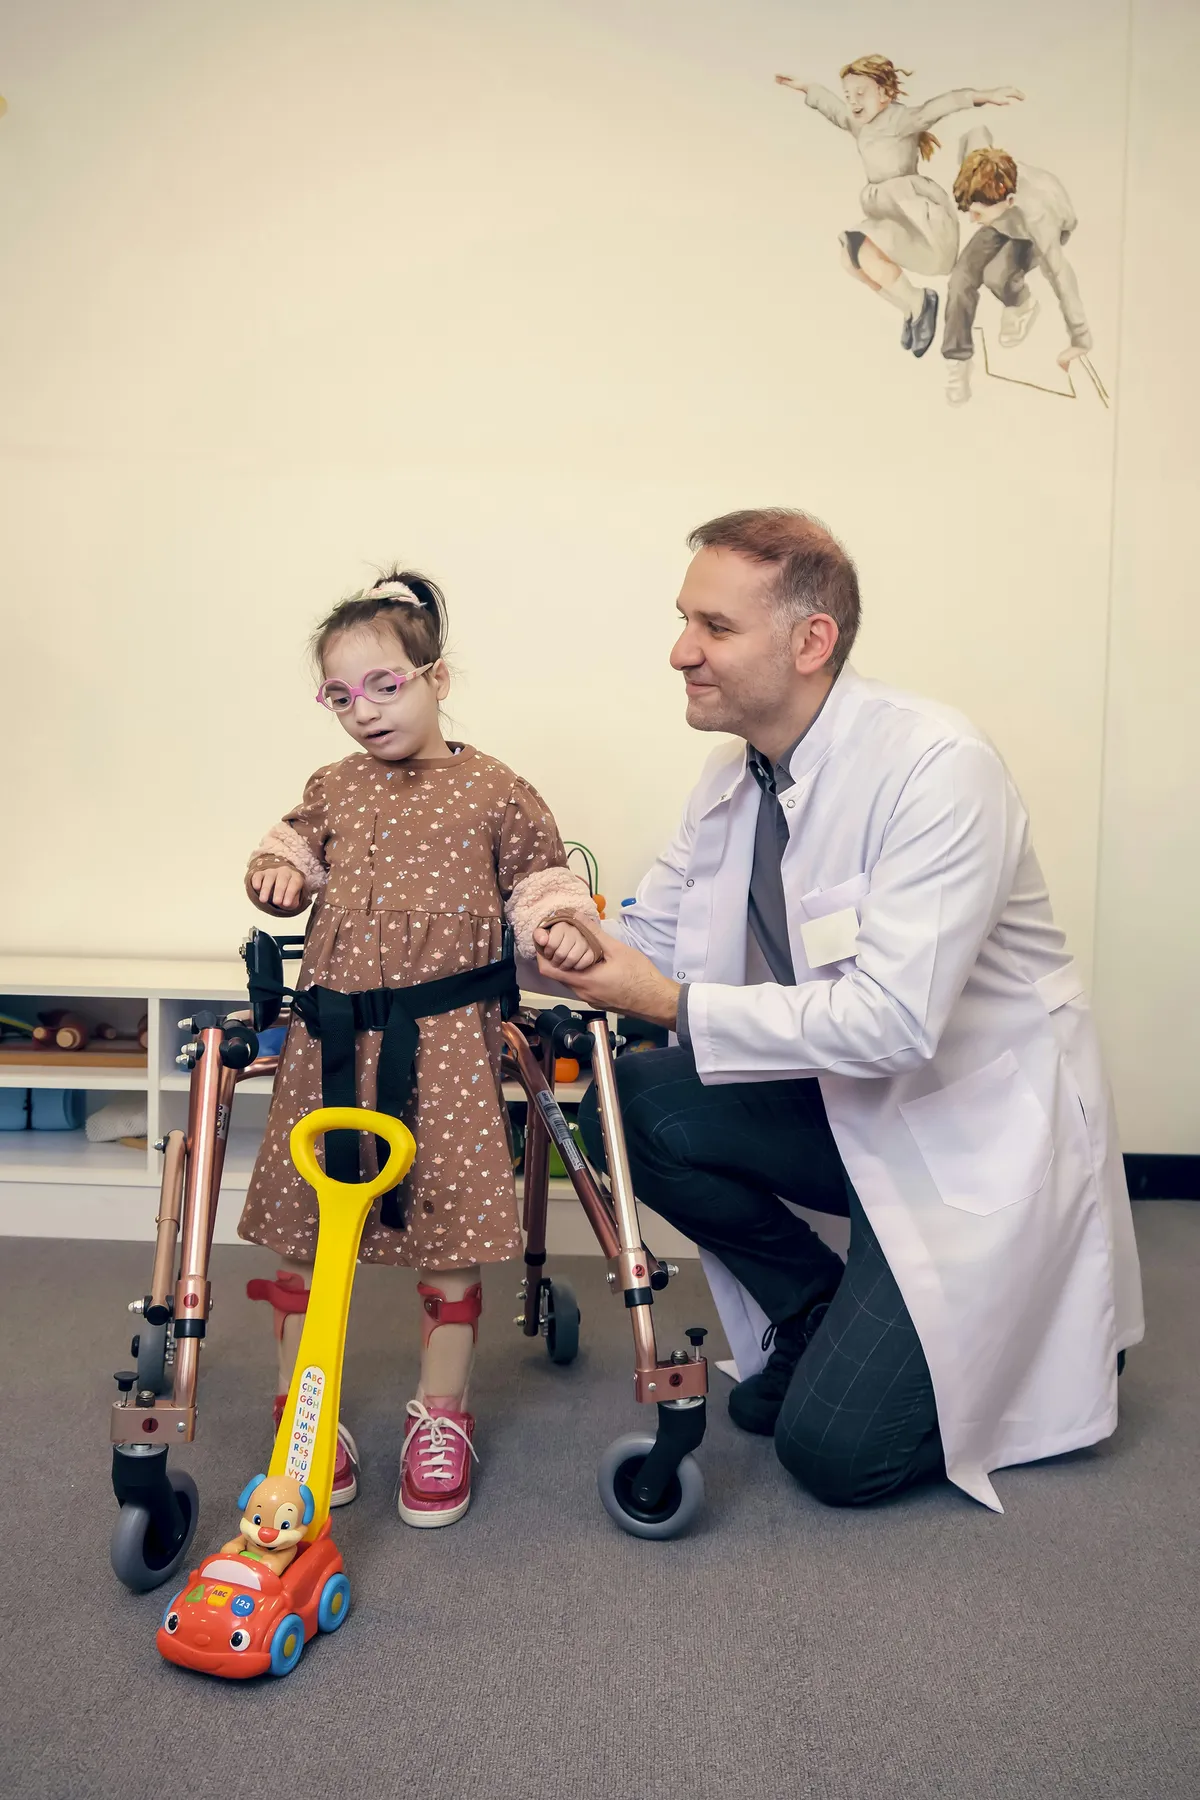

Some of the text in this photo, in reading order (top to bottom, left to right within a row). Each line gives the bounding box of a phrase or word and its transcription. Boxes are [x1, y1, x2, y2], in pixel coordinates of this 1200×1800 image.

[305, 1371, 323, 1385] ABC
[302, 1382, 322, 1397] ÇDEF
[299, 1394, 320, 1409] GĞH
[295, 1419, 315, 1434] LMN
[293, 1432, 313, 1446] OÖP
[293, 1443, 309, 1460] RSŞ
[290, 1456, 307, 1471] TUÜ
[288, 1469, 305, 1483] VYZ
[212, 1589, 228, 1598] ABC
[235, 1598, 251, 1610] 123
